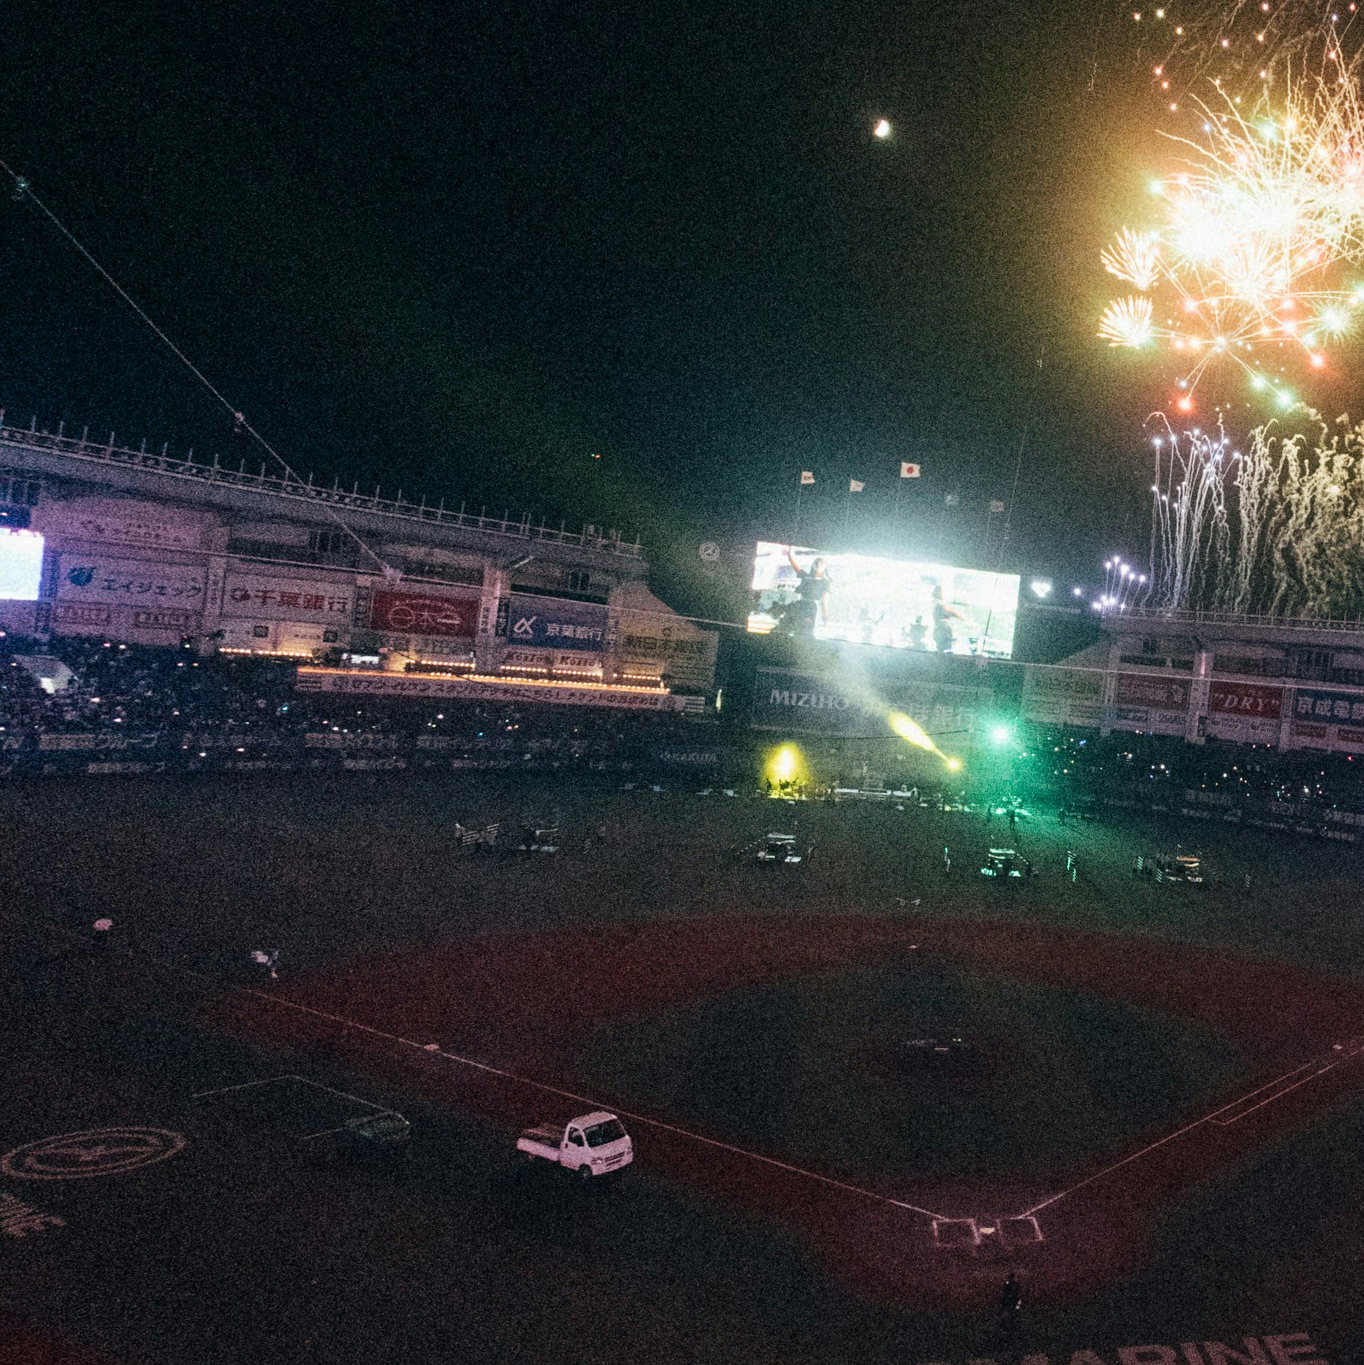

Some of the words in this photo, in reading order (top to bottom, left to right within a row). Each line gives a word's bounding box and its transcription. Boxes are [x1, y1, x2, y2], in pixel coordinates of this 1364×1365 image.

[101, 577, 203, 598] エイジェック
[253, 588, 349, 613] 千葉銀行
[545, 622, 603, 642] 京葉銀行
[768, 688, 851, 711] MIZUHO
